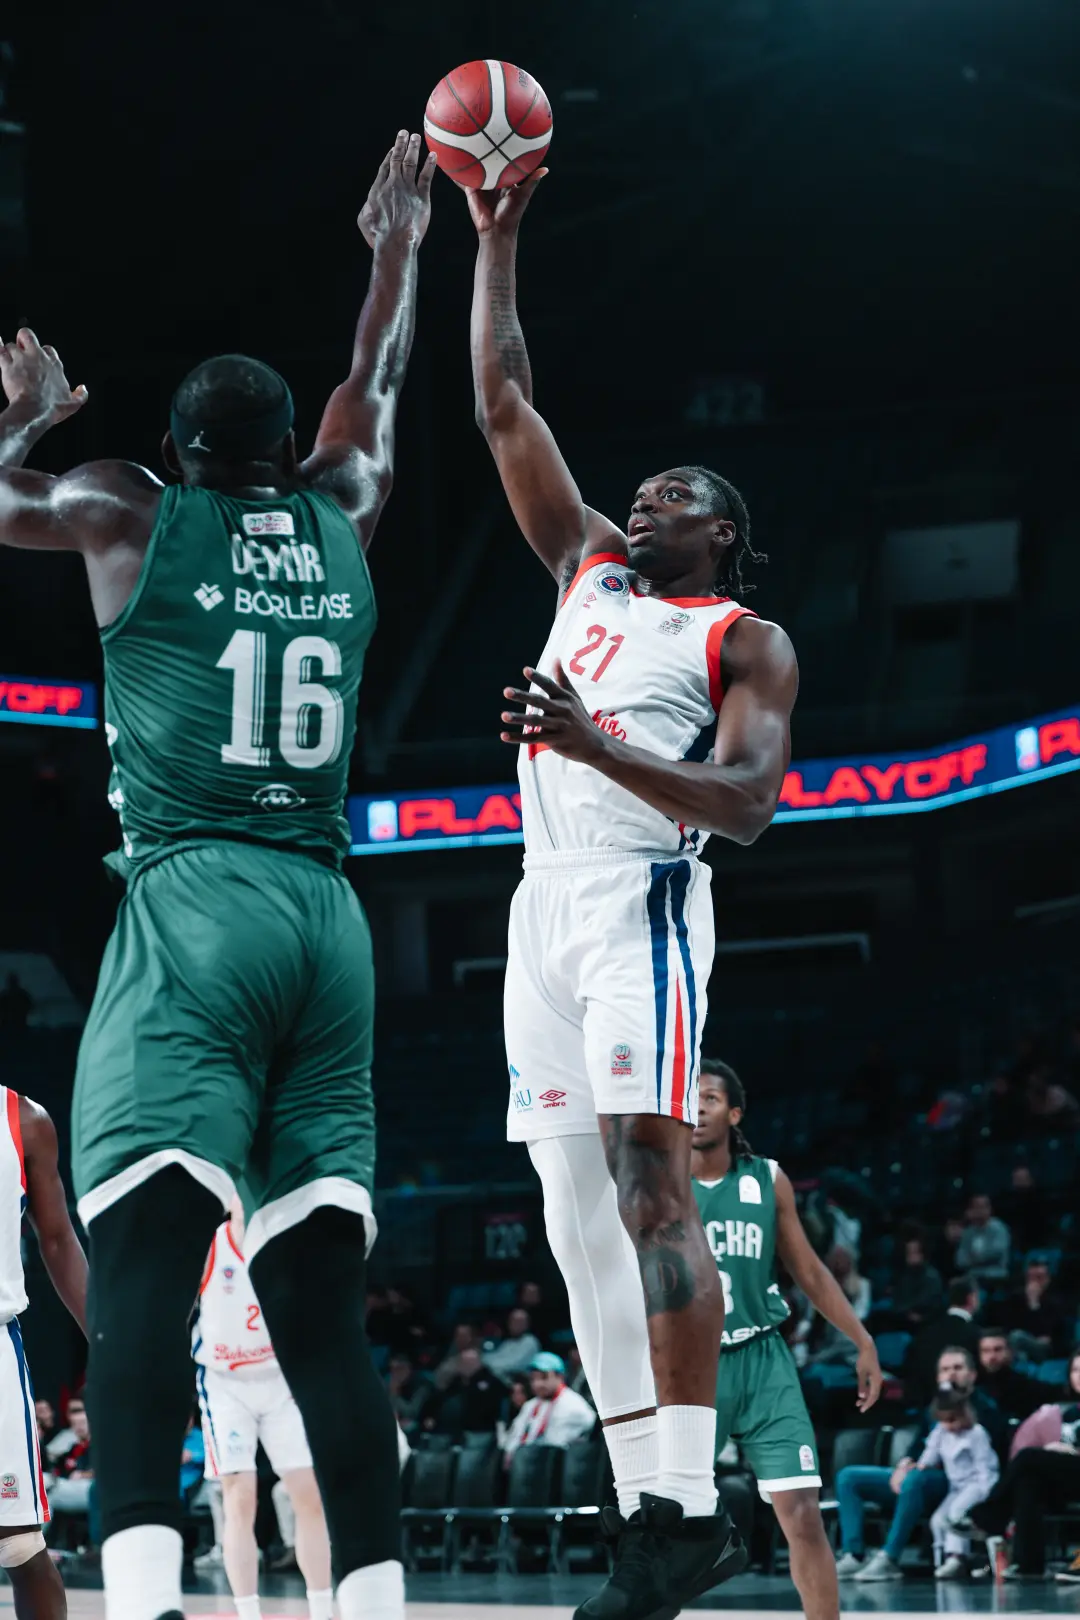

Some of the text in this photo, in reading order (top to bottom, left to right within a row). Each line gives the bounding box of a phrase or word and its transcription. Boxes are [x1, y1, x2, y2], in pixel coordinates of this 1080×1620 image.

[231, 533, 325, 583] DEMİR
[234, 587, 354, 620] BORLEASE
[569, 624, 625, 683] 21
[216, 629, 344, 769] 16
[780, 745, 987, 805] LAYOFF
[542, 1101, 567, 1109] umbro
[703, 1219, 764, 1263] ÇKA
[245, 1304, 261, 1331] 2
